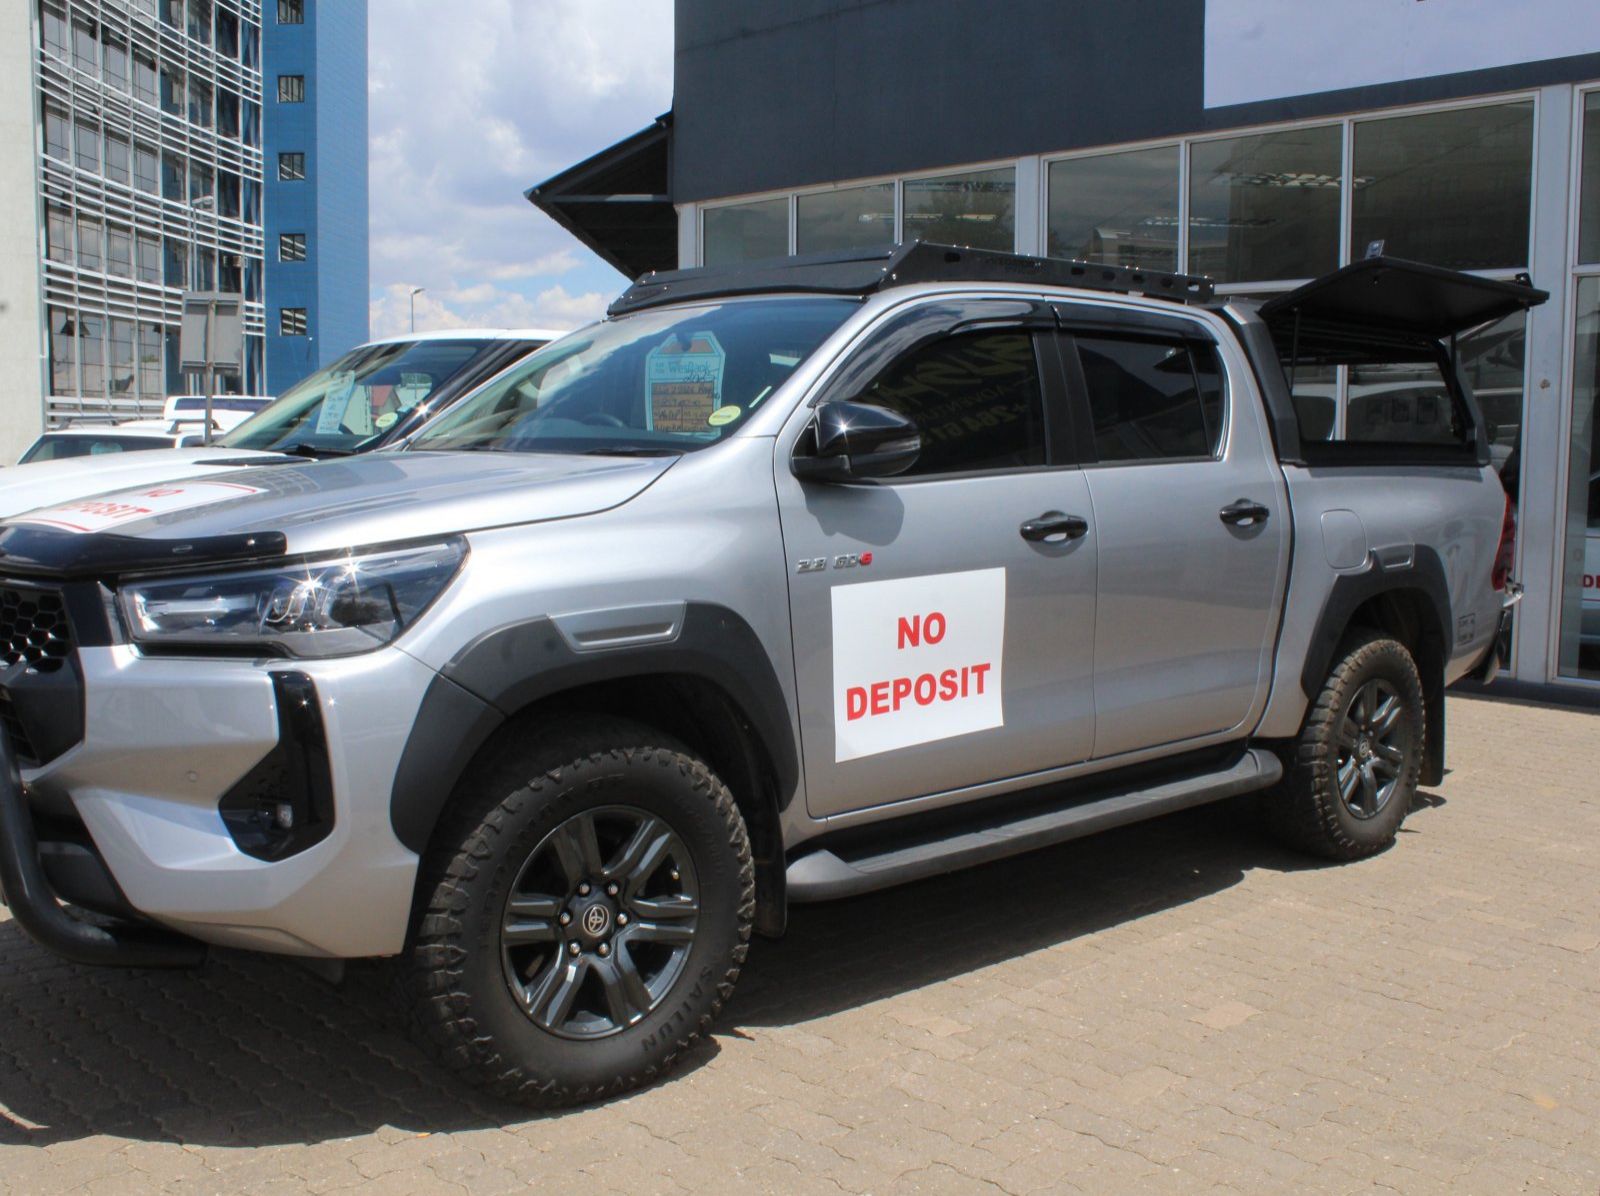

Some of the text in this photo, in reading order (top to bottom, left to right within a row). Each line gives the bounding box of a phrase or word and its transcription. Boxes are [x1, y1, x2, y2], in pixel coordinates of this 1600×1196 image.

[897, 612, 947, 650] NO
[846, 663, 991, 721] DEPOSIT
[641, 965, 713, 1051] SAILUN
